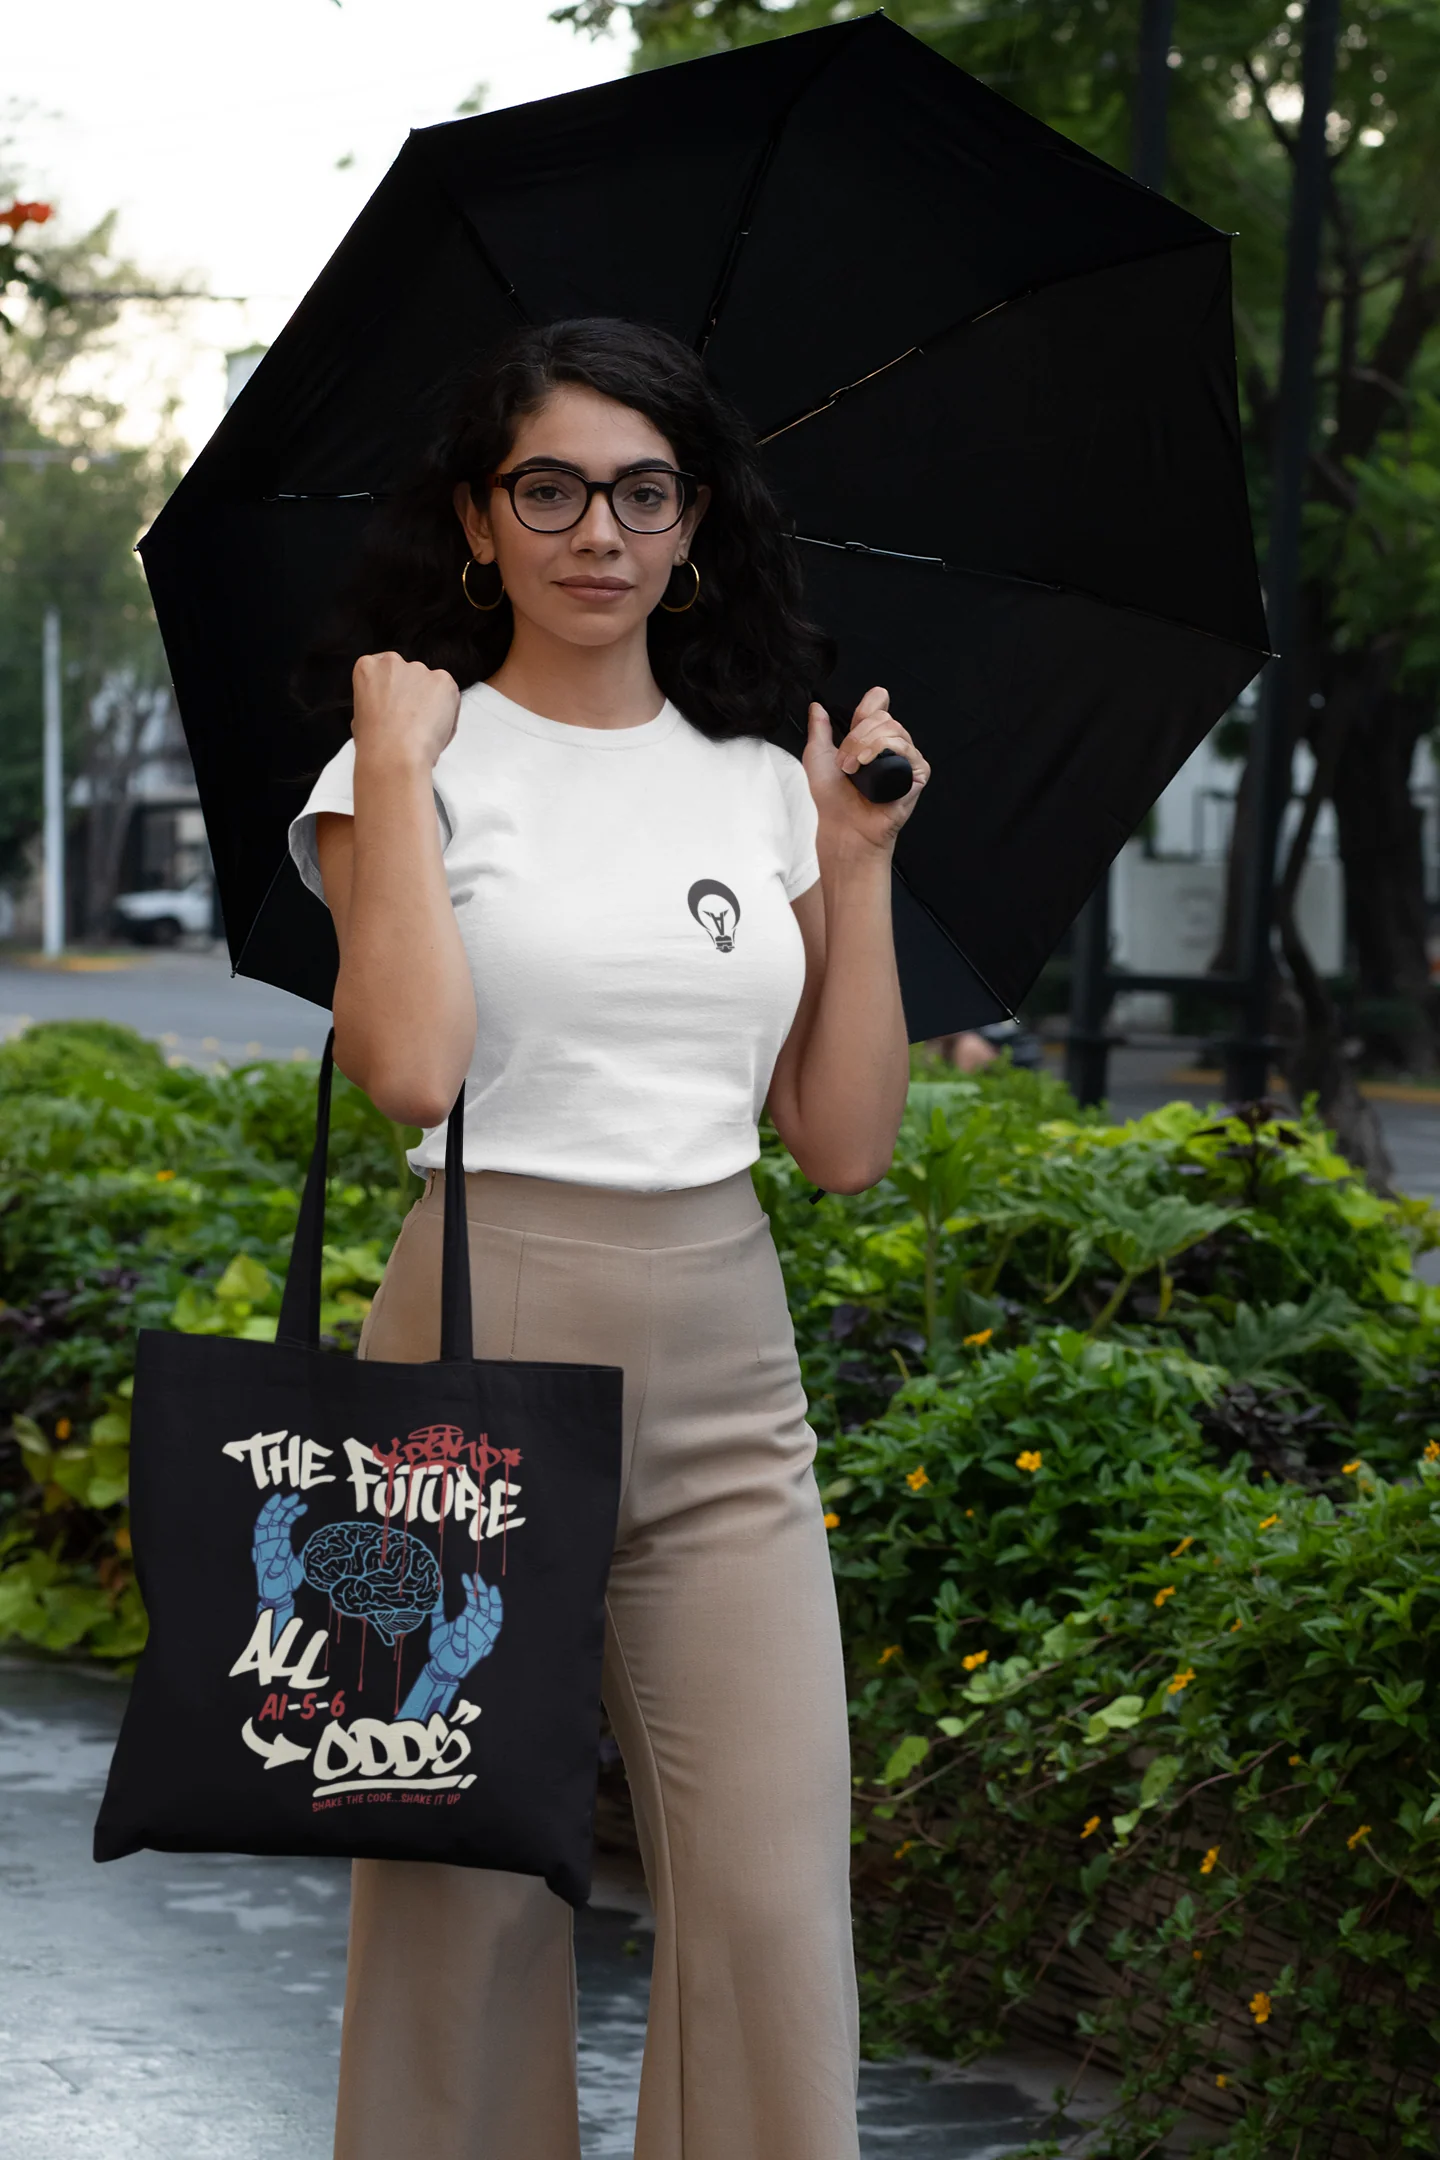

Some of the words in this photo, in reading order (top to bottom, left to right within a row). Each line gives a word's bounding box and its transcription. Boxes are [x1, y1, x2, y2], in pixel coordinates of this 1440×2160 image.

[222, 1430, 336, 1490] THE
[342, 1437, 526, 1541] FUTURE
[229, 1609, 330, 1689] ALL
[311, 1796, 344, 1813] SHAKE
[345, 1794, 365, 1805] THE
[433, 1794, 445, 1805] IT
[447, 1793, 461, 1805] UP
